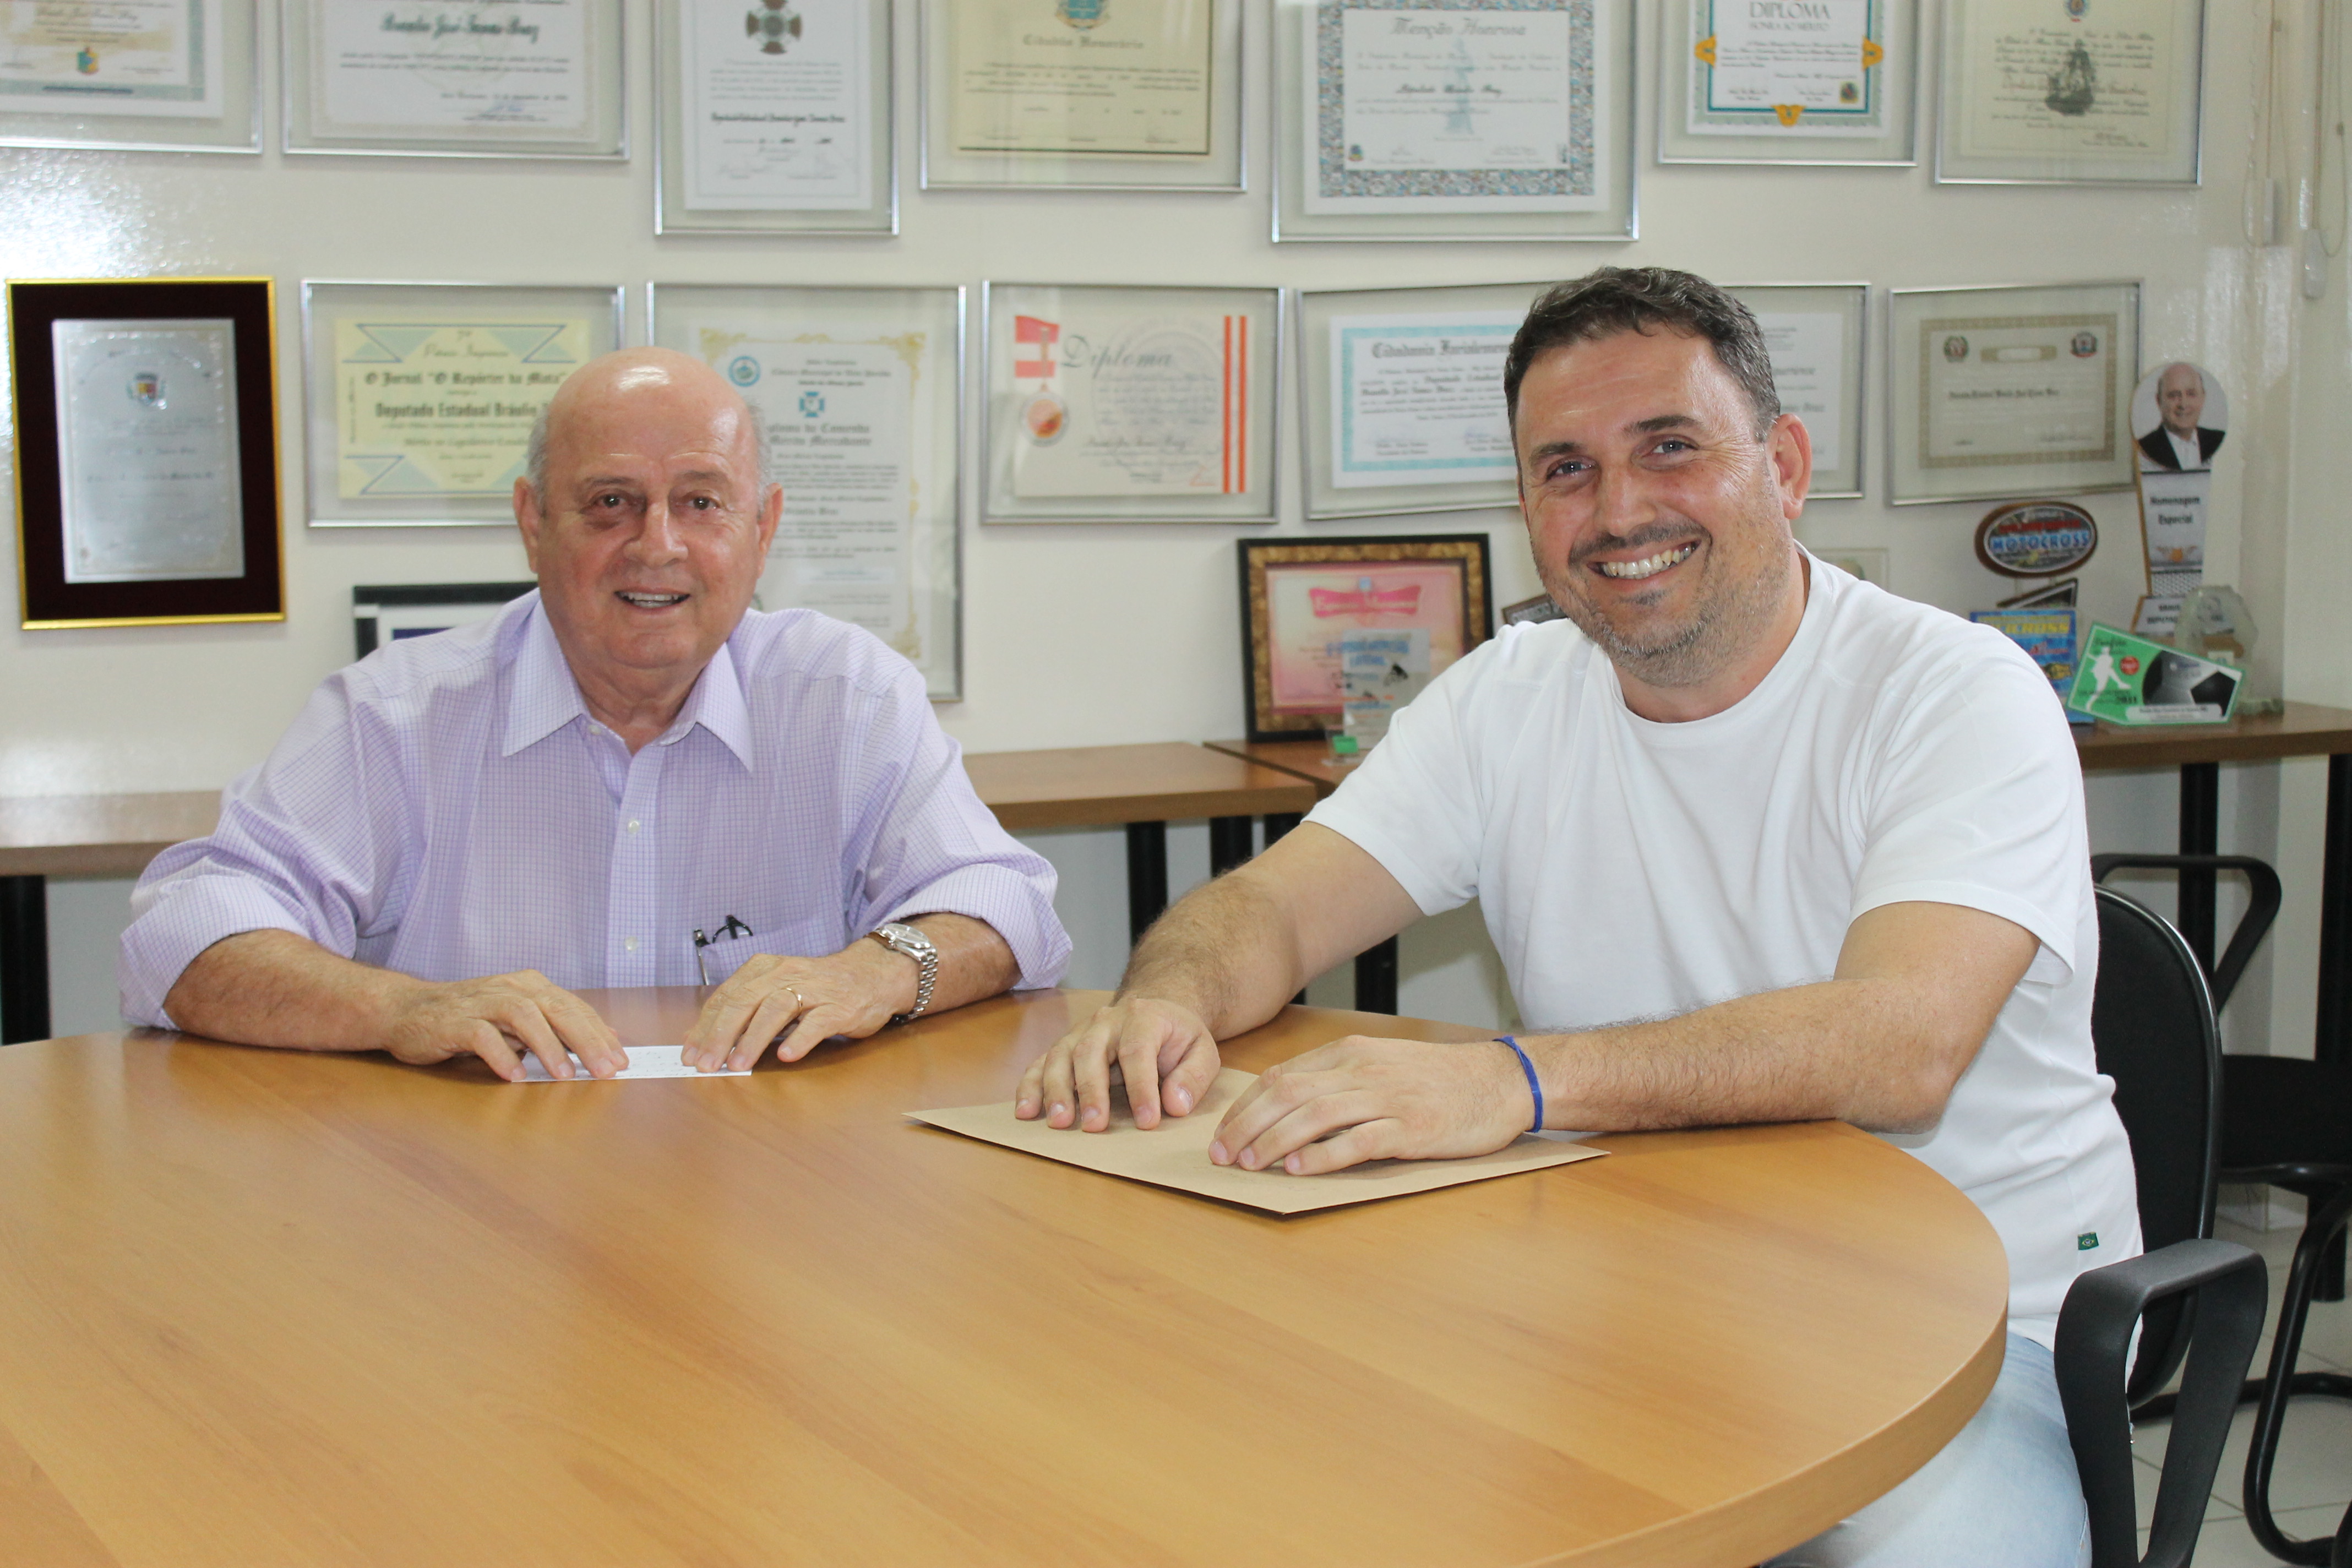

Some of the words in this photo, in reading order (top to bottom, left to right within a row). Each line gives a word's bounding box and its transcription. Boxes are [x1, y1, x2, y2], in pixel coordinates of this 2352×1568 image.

[1750, 2, 1831, 19] DIPLOMA
[1061, 334, 1173, 379] Diploma
[375, 402, 434, 421] Deputado
[438, 401, 489, 417] Estadual
[2158, 514, 2194, 525] Especial
[1992, 530, 2090, 551] MOTOCROSS
